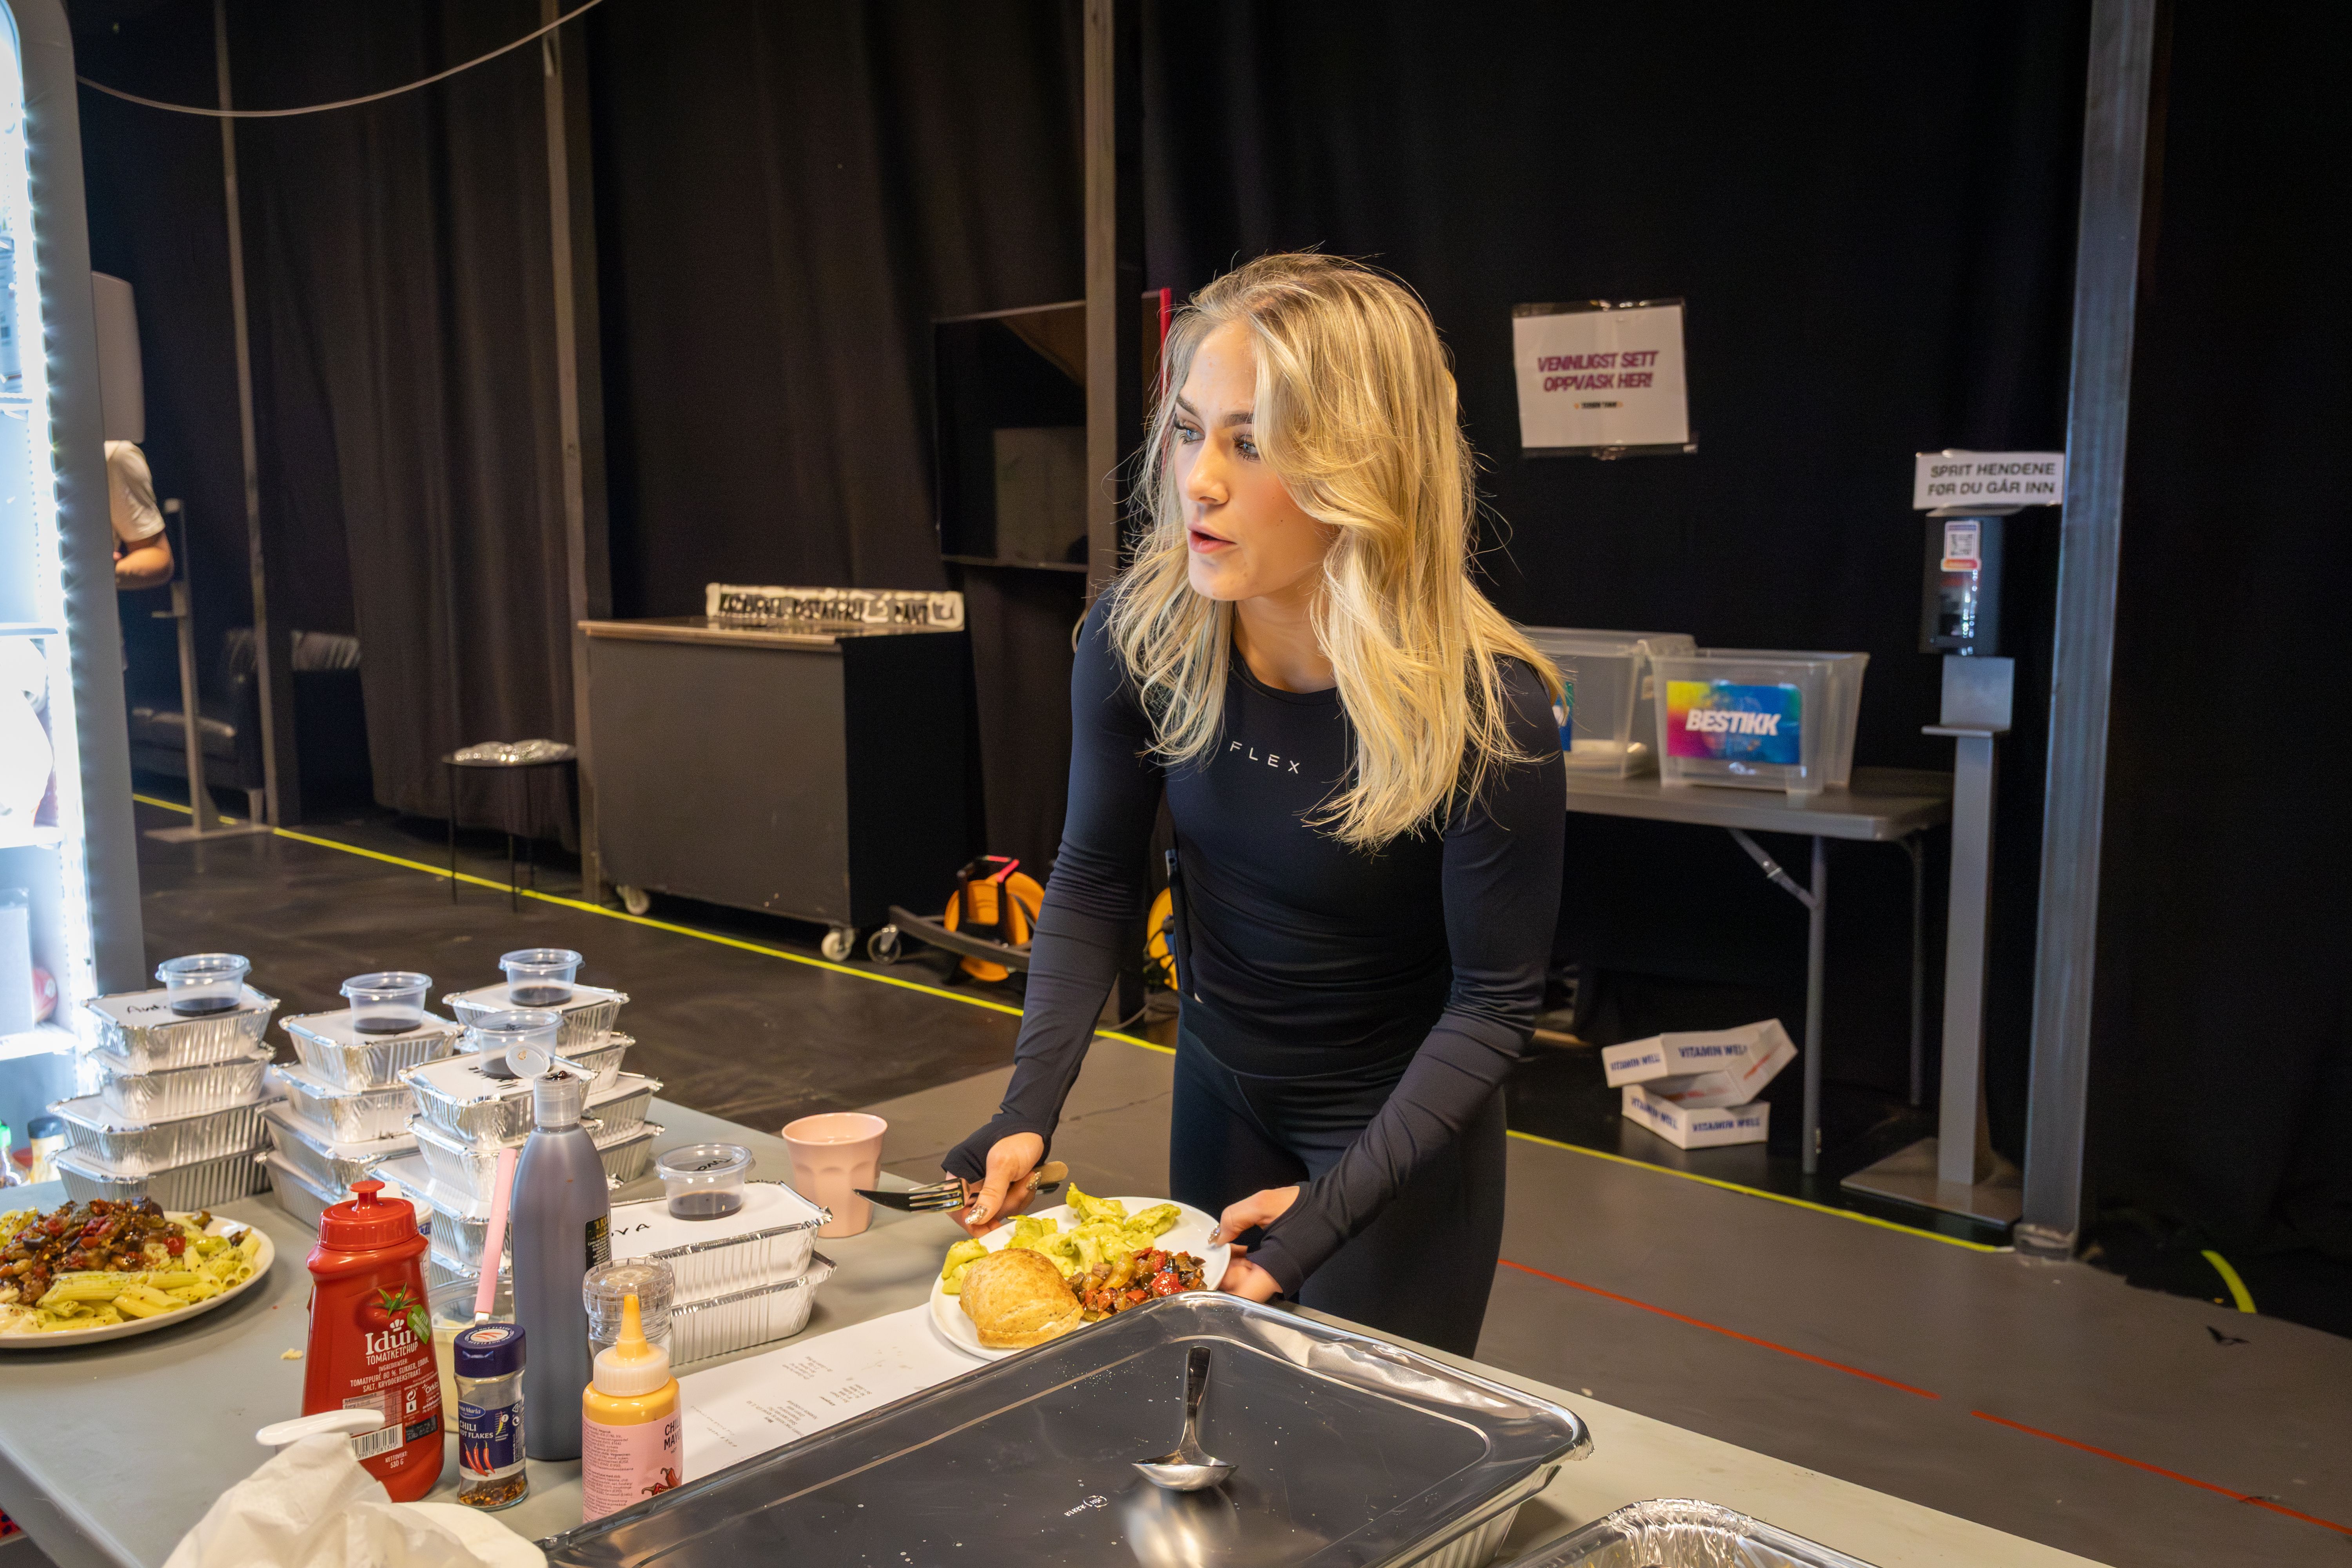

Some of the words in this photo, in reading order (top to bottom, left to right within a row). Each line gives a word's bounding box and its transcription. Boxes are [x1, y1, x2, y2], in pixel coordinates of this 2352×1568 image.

[1537, 353, 1618, 372] VENNLIGST
[1621, 350, 1659, 368] SETT
[1543, 373, 1616, 392] OPPVASK
[1617, 372, 1653, 388] HER!
[1930, 463, 1973, 477] SPRIT
[1975, 462, 2056, 476] HENDENE
[1927, 483, 1956, 495] FØR
[1959, 482, 1983, 494] DU
[1986, 479, 2020, 494] GÅR
[2025, 482, 2055, 494] INN
[1685, 709, 1782, 736] BESTIKK
[1230, 741, 1300, 774] FLEX
[1679, 1045, 1723, 1057] VITAMIN
[365, 1329, 418, 1356] Idun
[366, 1341, 418, 1366] TOMATKETCHUP
[350, 1373, 381, 1387] TOMATPURÉ
[363, 1384, 377, 1393] SALT,
[459, 1420, 476, 1432] CHILI
[664, 1414, 680, 1436] CHILI
[664, 1428, 681, 1451] MAYO
